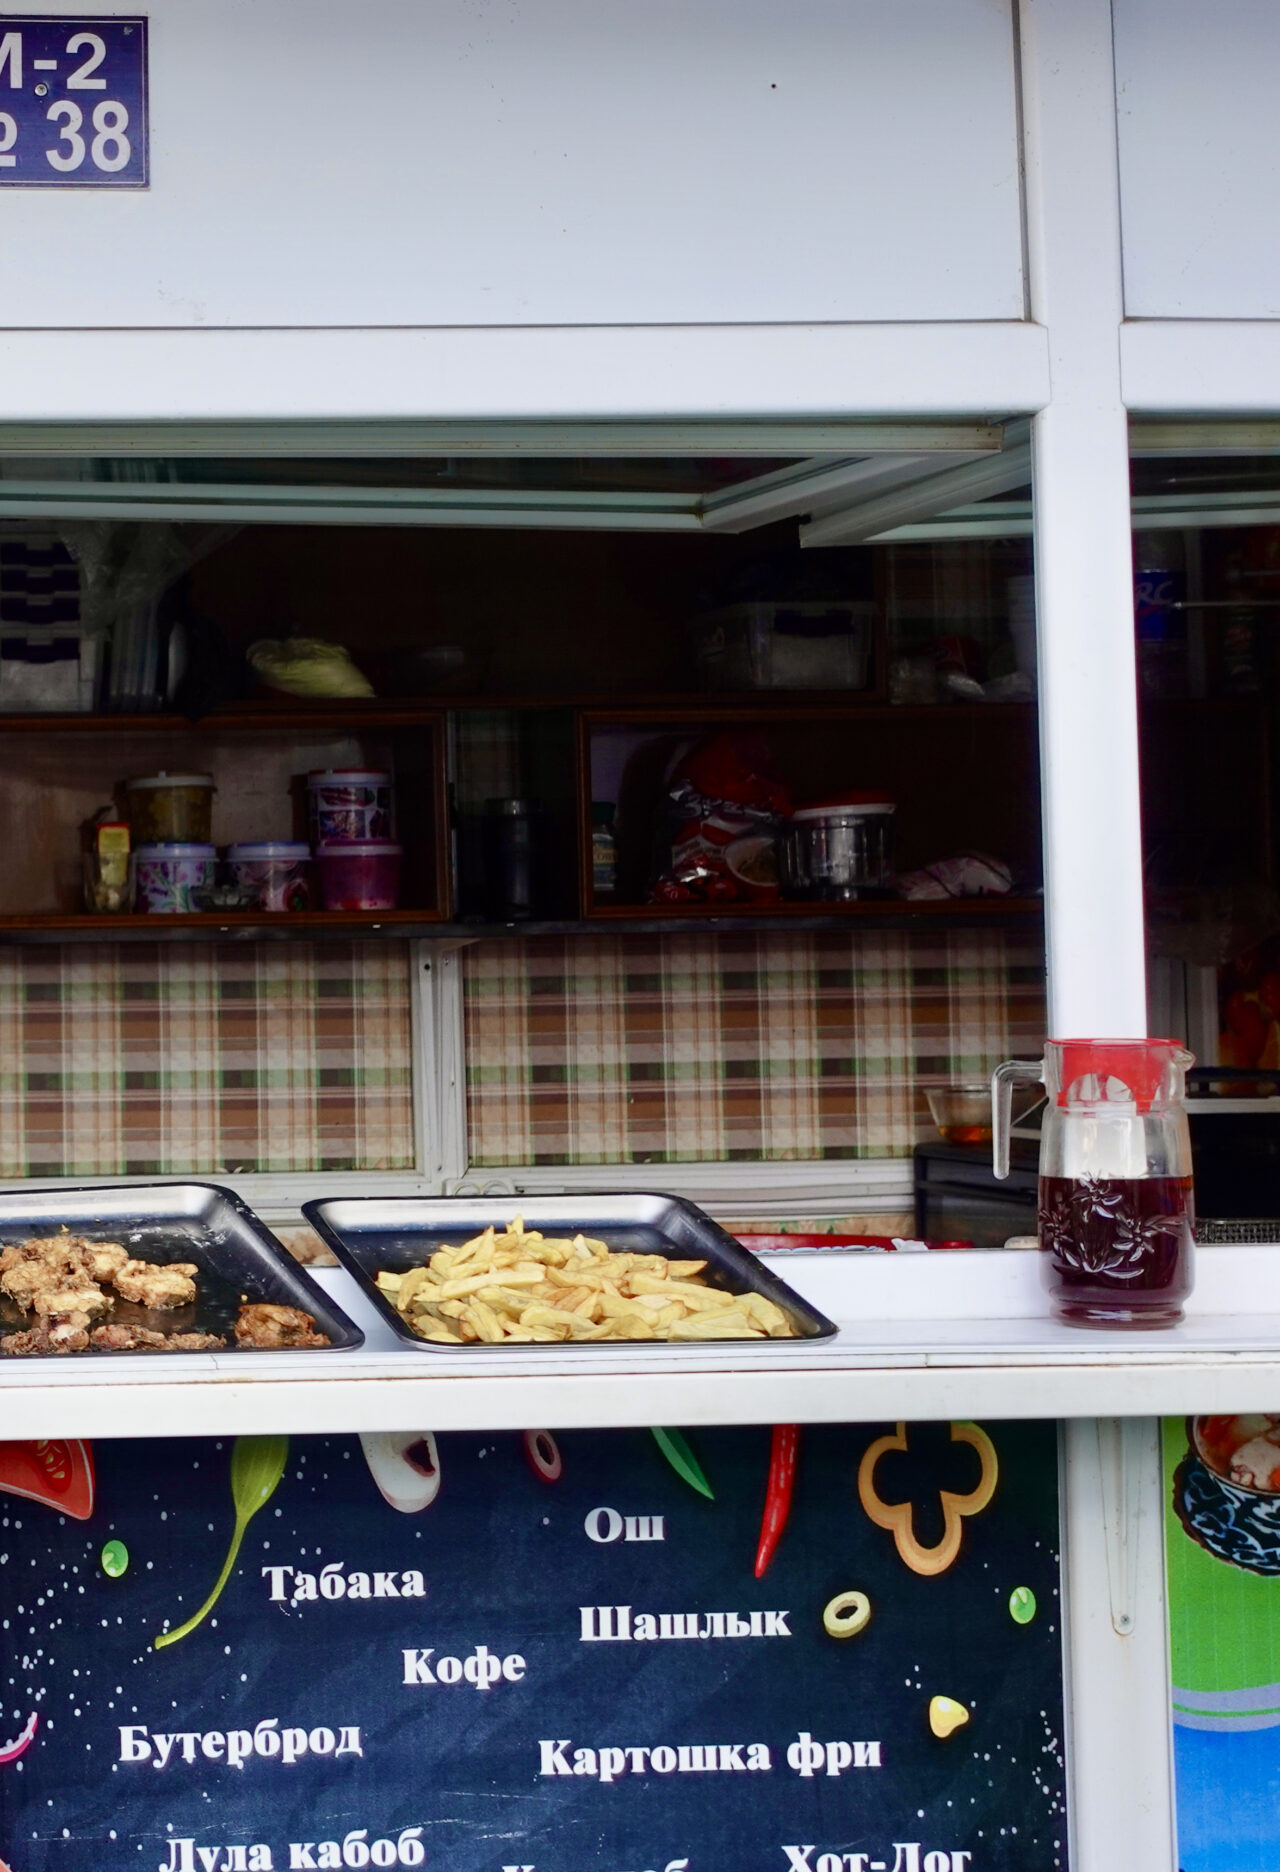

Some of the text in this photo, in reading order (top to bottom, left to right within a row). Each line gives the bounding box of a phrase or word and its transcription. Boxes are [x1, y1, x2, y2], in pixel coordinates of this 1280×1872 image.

[46, 100, 131, 173] 38
[585, 1508, 665, 1543] Ош
[265, 1562, 426, 1603] Табака
[579, 1606, 791, 1641] Шашлык
[402, 1646, 526, 1691] Кофе
[118, 1719, 363, 1768] Бутерброд
[538, 1733, 882, 1780] Картошка фри
[159, 1827, 426, 1872] Лула кабоб
[782, 1843, 971, 1872] Хот-Дог
